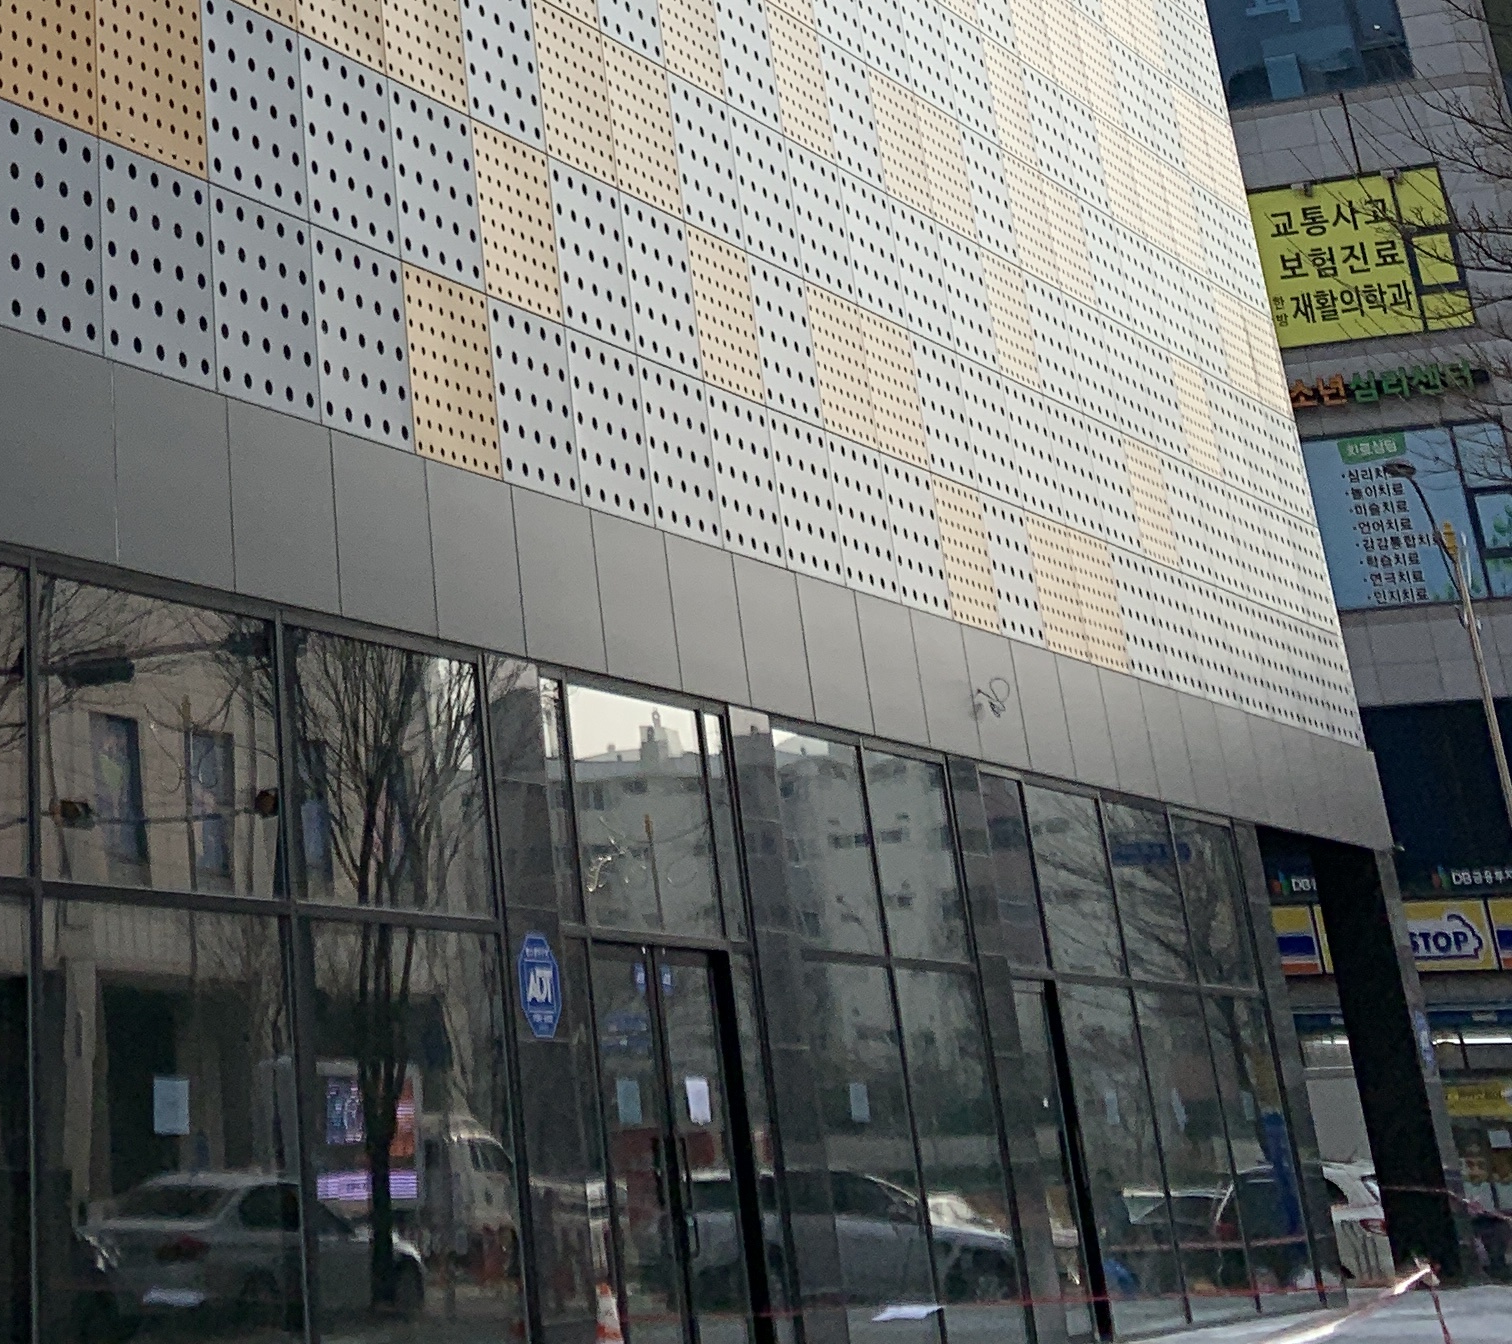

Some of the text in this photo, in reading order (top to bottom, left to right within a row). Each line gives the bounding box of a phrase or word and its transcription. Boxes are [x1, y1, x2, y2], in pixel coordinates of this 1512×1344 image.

[1270, 198, 1394, 237] 교통사고
[1280, 240, 1405, 279] 보험진료
[1290, 279, 1413, 324] 재활의학과
[1348, 465, 1389, 483] 심리치
[527, 966, 554, 1003] ADT
